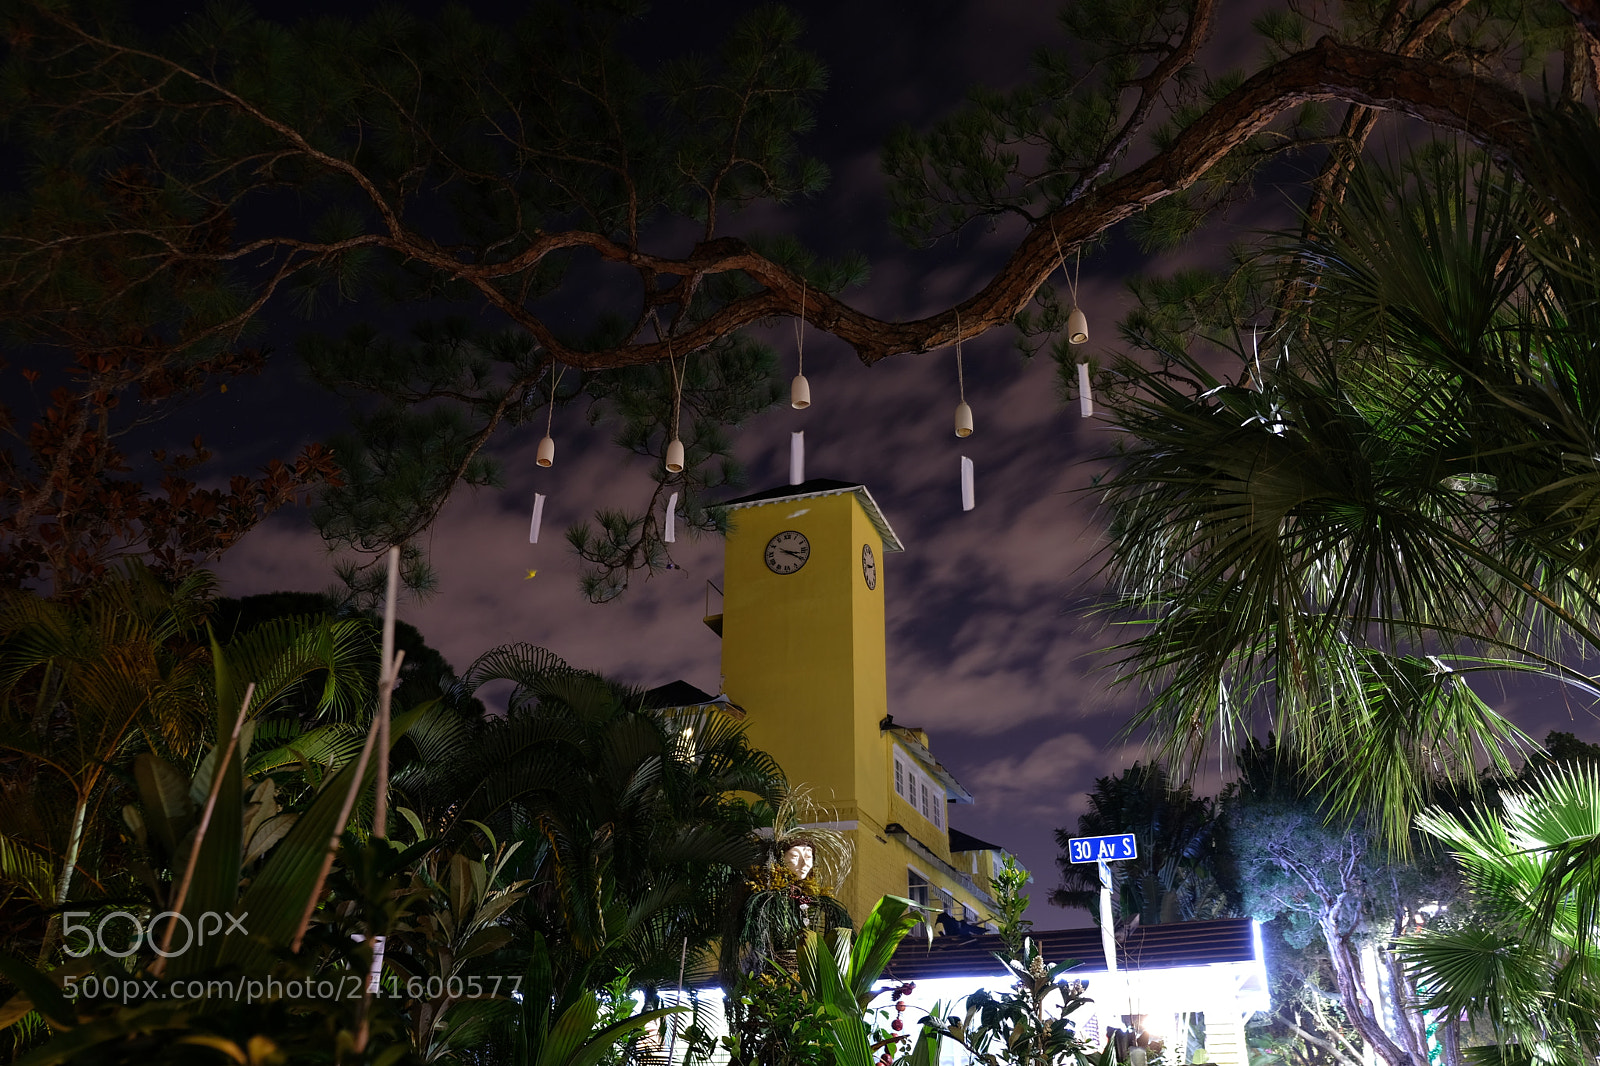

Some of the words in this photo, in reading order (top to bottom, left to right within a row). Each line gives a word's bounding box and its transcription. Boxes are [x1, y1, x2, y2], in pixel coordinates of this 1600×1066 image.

[1073, 841, 1091, 860] 30
[1098, 839, 1115, 857] Av
[1122, 837, 1132, 856] S
